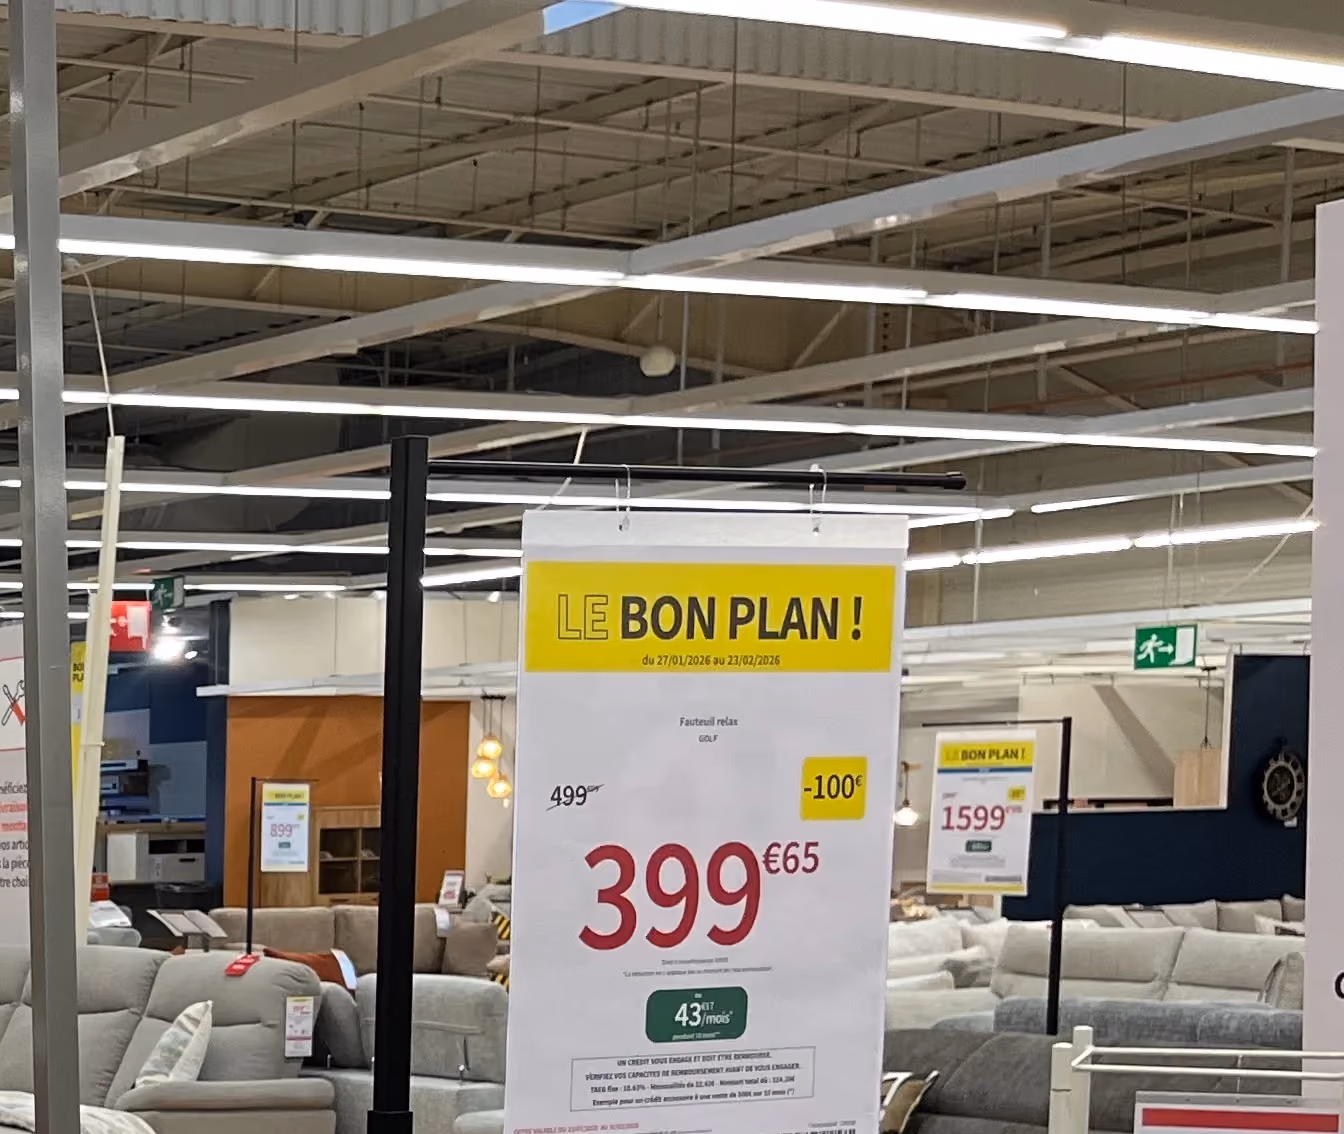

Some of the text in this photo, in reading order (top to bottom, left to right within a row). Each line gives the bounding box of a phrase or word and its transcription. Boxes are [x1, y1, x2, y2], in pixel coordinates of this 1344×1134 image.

[557, 593, 609, 640] LE
[621, 595, 715, 641] BON
[729, 596, 839, 641] PLAN
[642, 653, 781, 668] du 27/01/2026 au 23/02/2026
[679, 716, 738, 728] Fauteuil relax
[961, 748, 1019, 761] BON PLAN
[804, 774, 862, 800] -100€
[12, 876, 30, 888] choi
